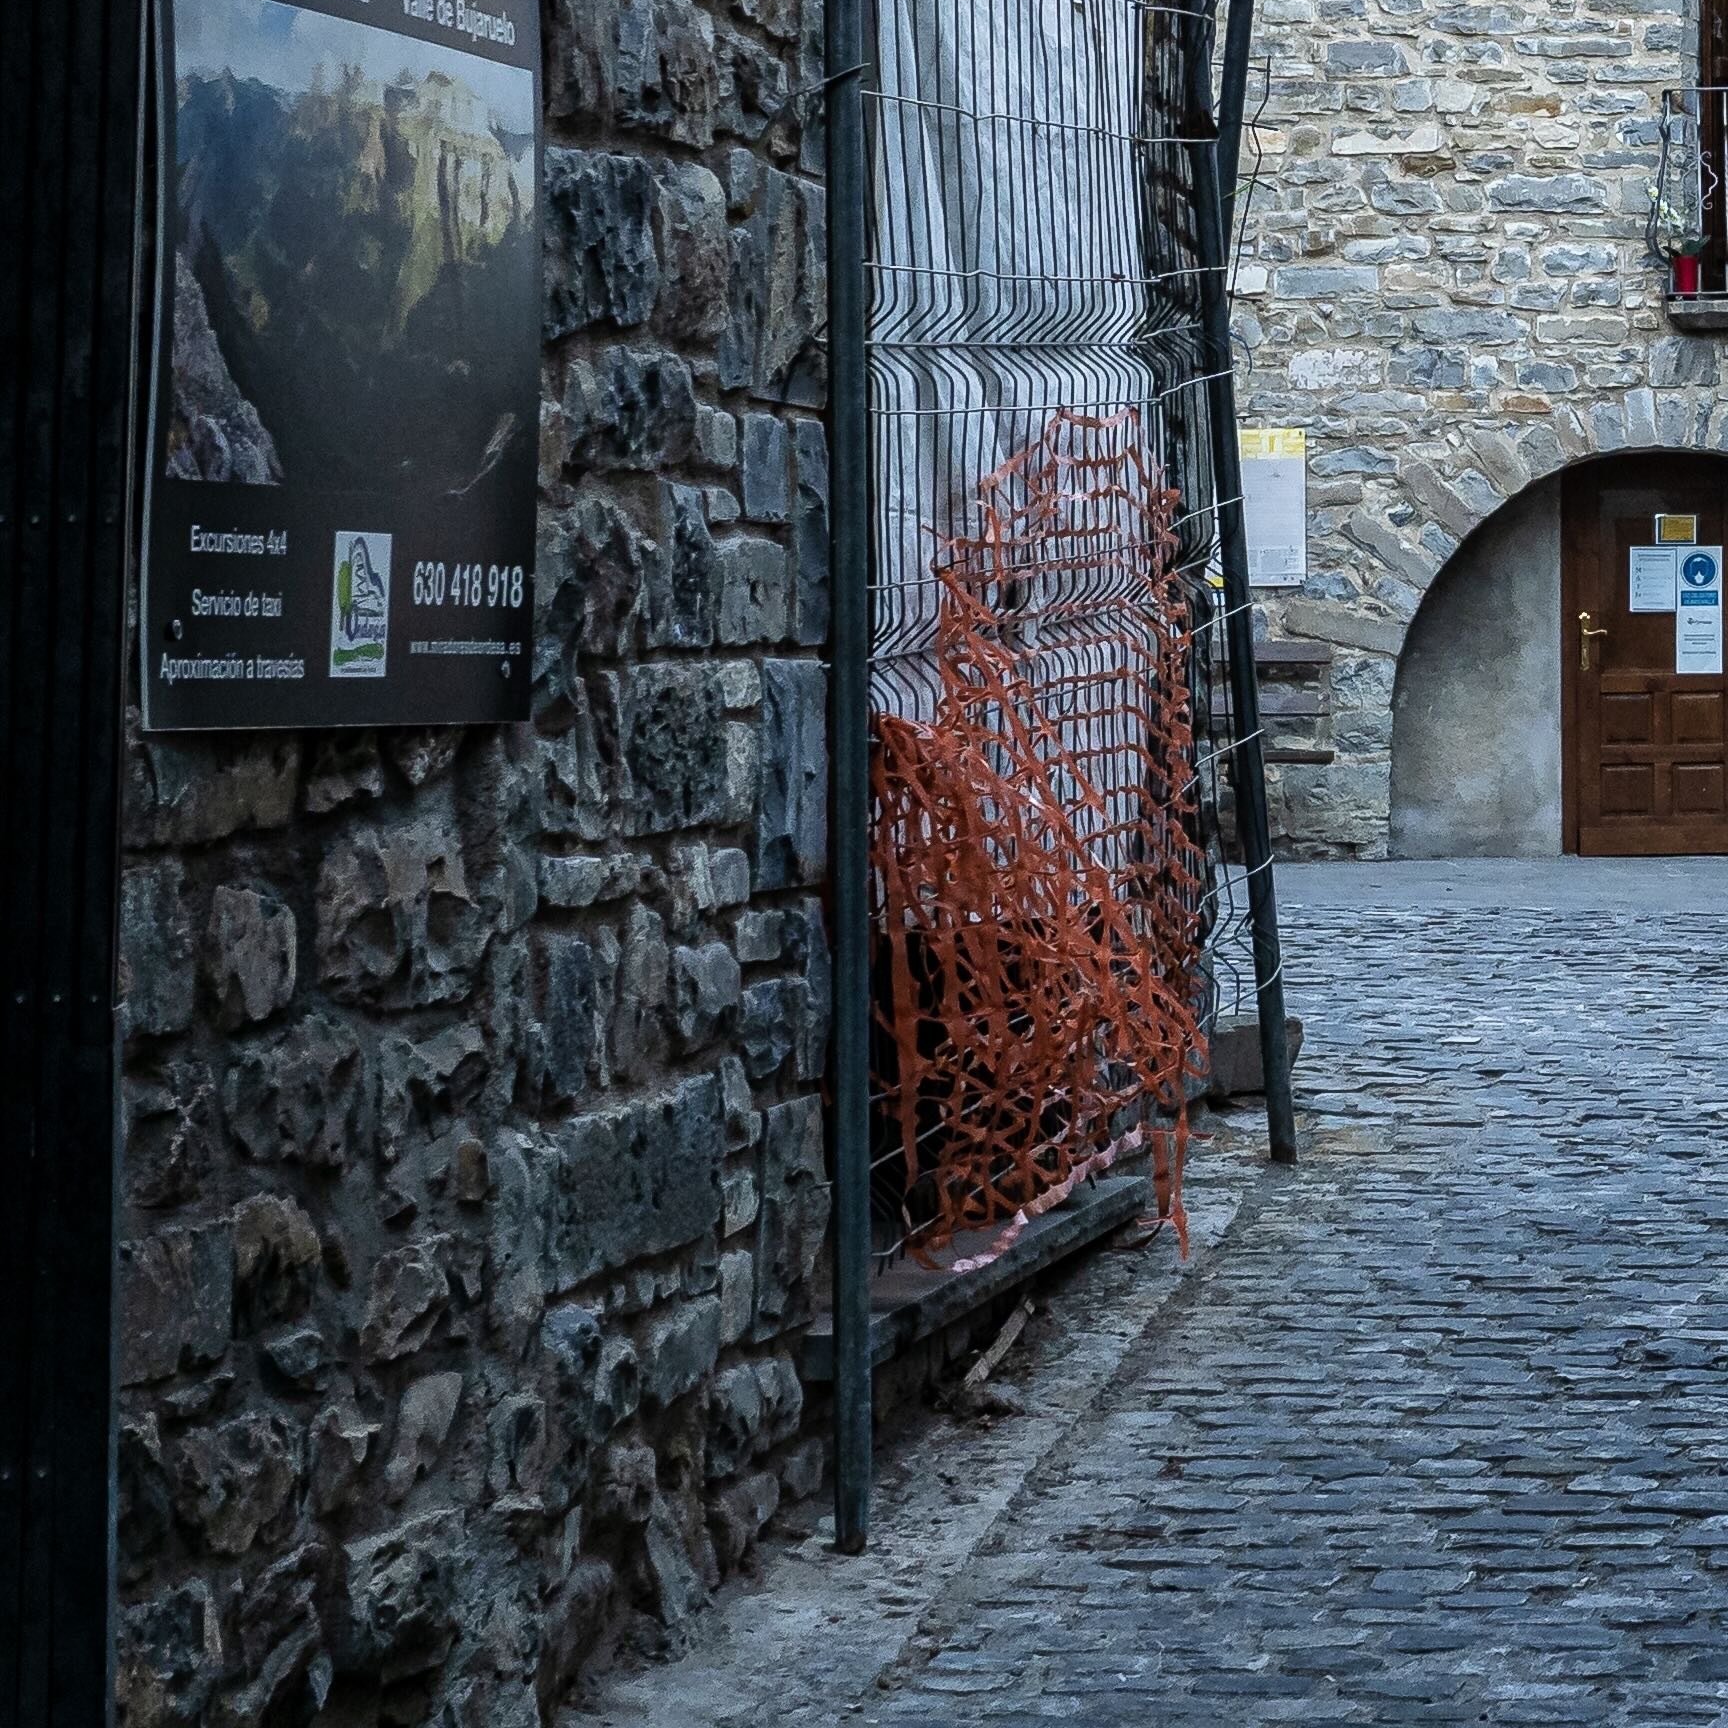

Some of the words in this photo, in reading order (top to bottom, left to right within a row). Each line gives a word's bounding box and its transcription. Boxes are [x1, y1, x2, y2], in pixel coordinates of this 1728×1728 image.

[190, 524, 265, 555] Excursiones
[266, 528, 288, 555] 4x4
[413, 561, 446, 606] 630
[450, 563, 483, 607] 418
[487, 564, 524, 608] 918
[191, 588, 242, 617] Servicio
[243, 589, 259, 617] de
[261, 591, 283, 617] taxi
[160, 651, 244, 686] Aproximación
[245, 659, 255, 680] a
